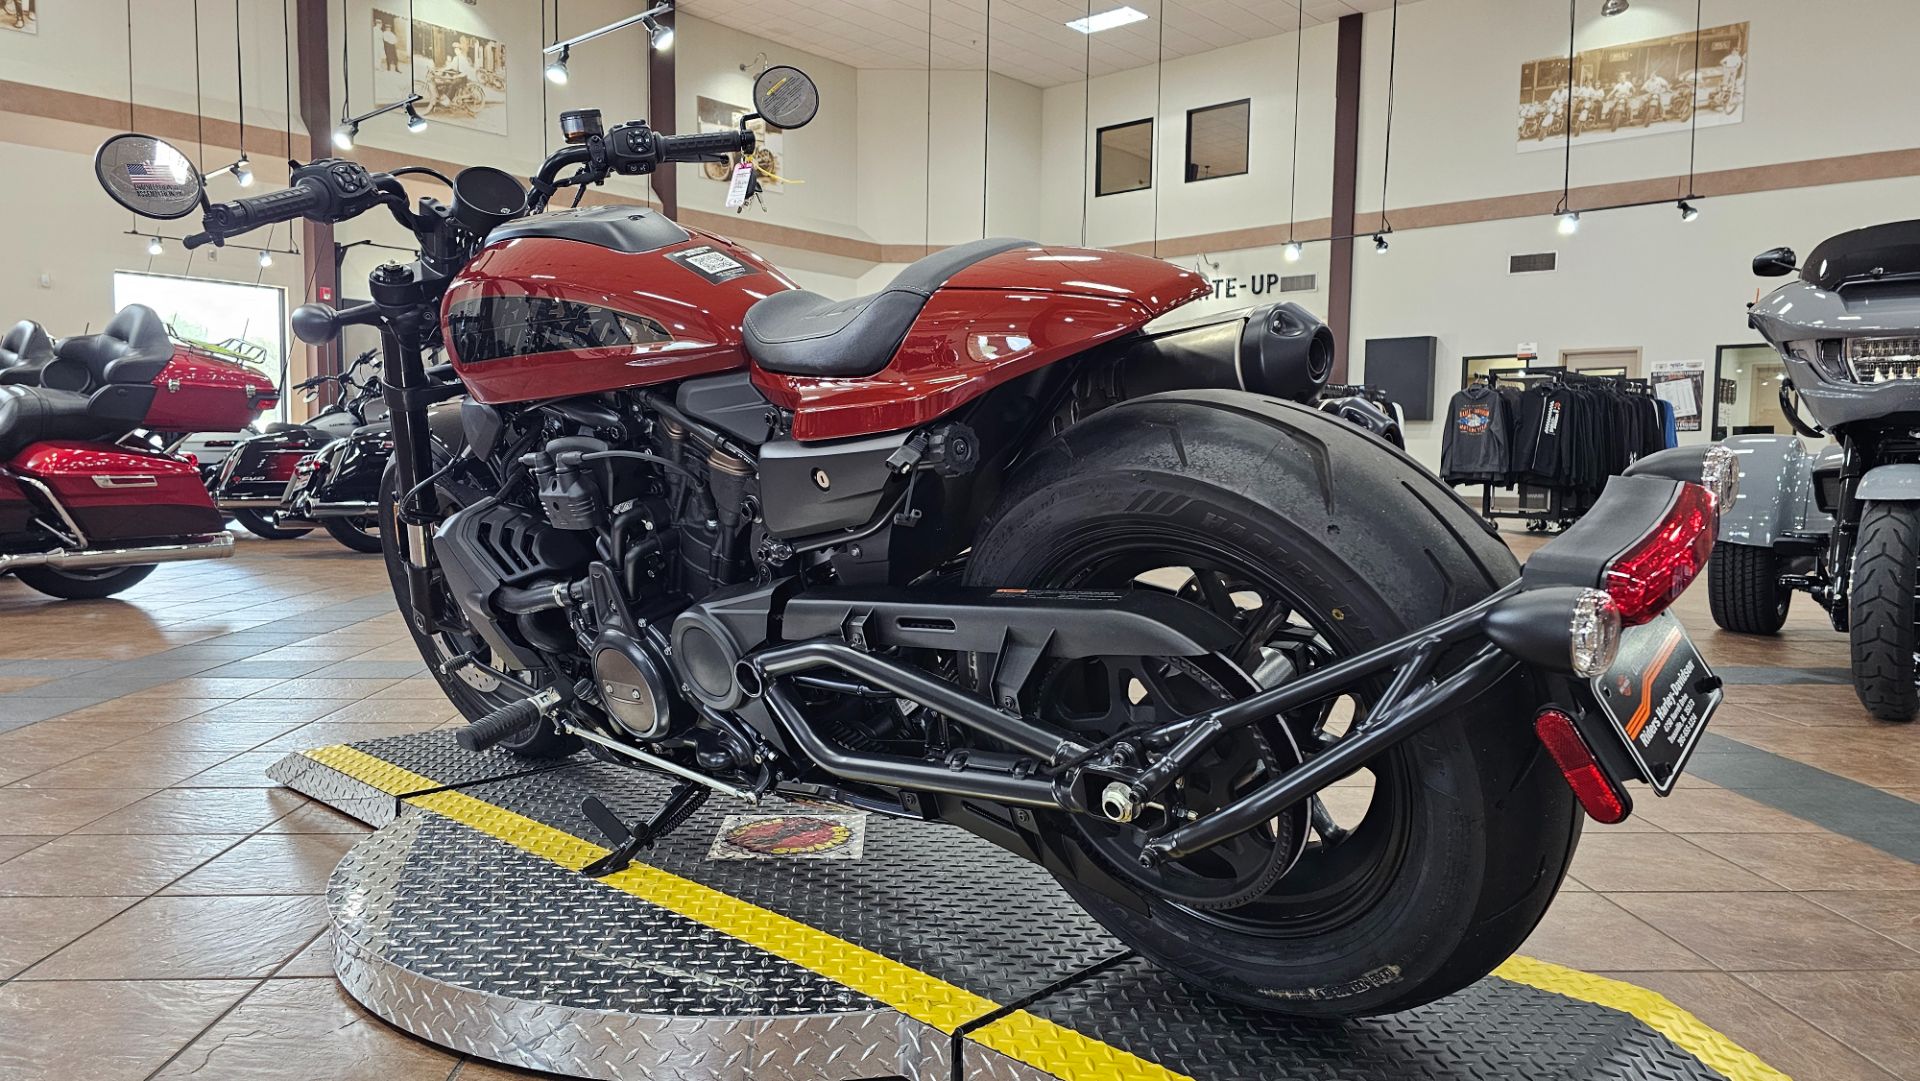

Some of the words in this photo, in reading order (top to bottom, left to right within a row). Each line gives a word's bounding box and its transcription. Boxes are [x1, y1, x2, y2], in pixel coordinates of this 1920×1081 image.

[1203, 273, 1279, 300] TE-UP
[1639, 717, 1661, 747] Riders
[1655, 660, 1695, 721] Harley-Davidson
